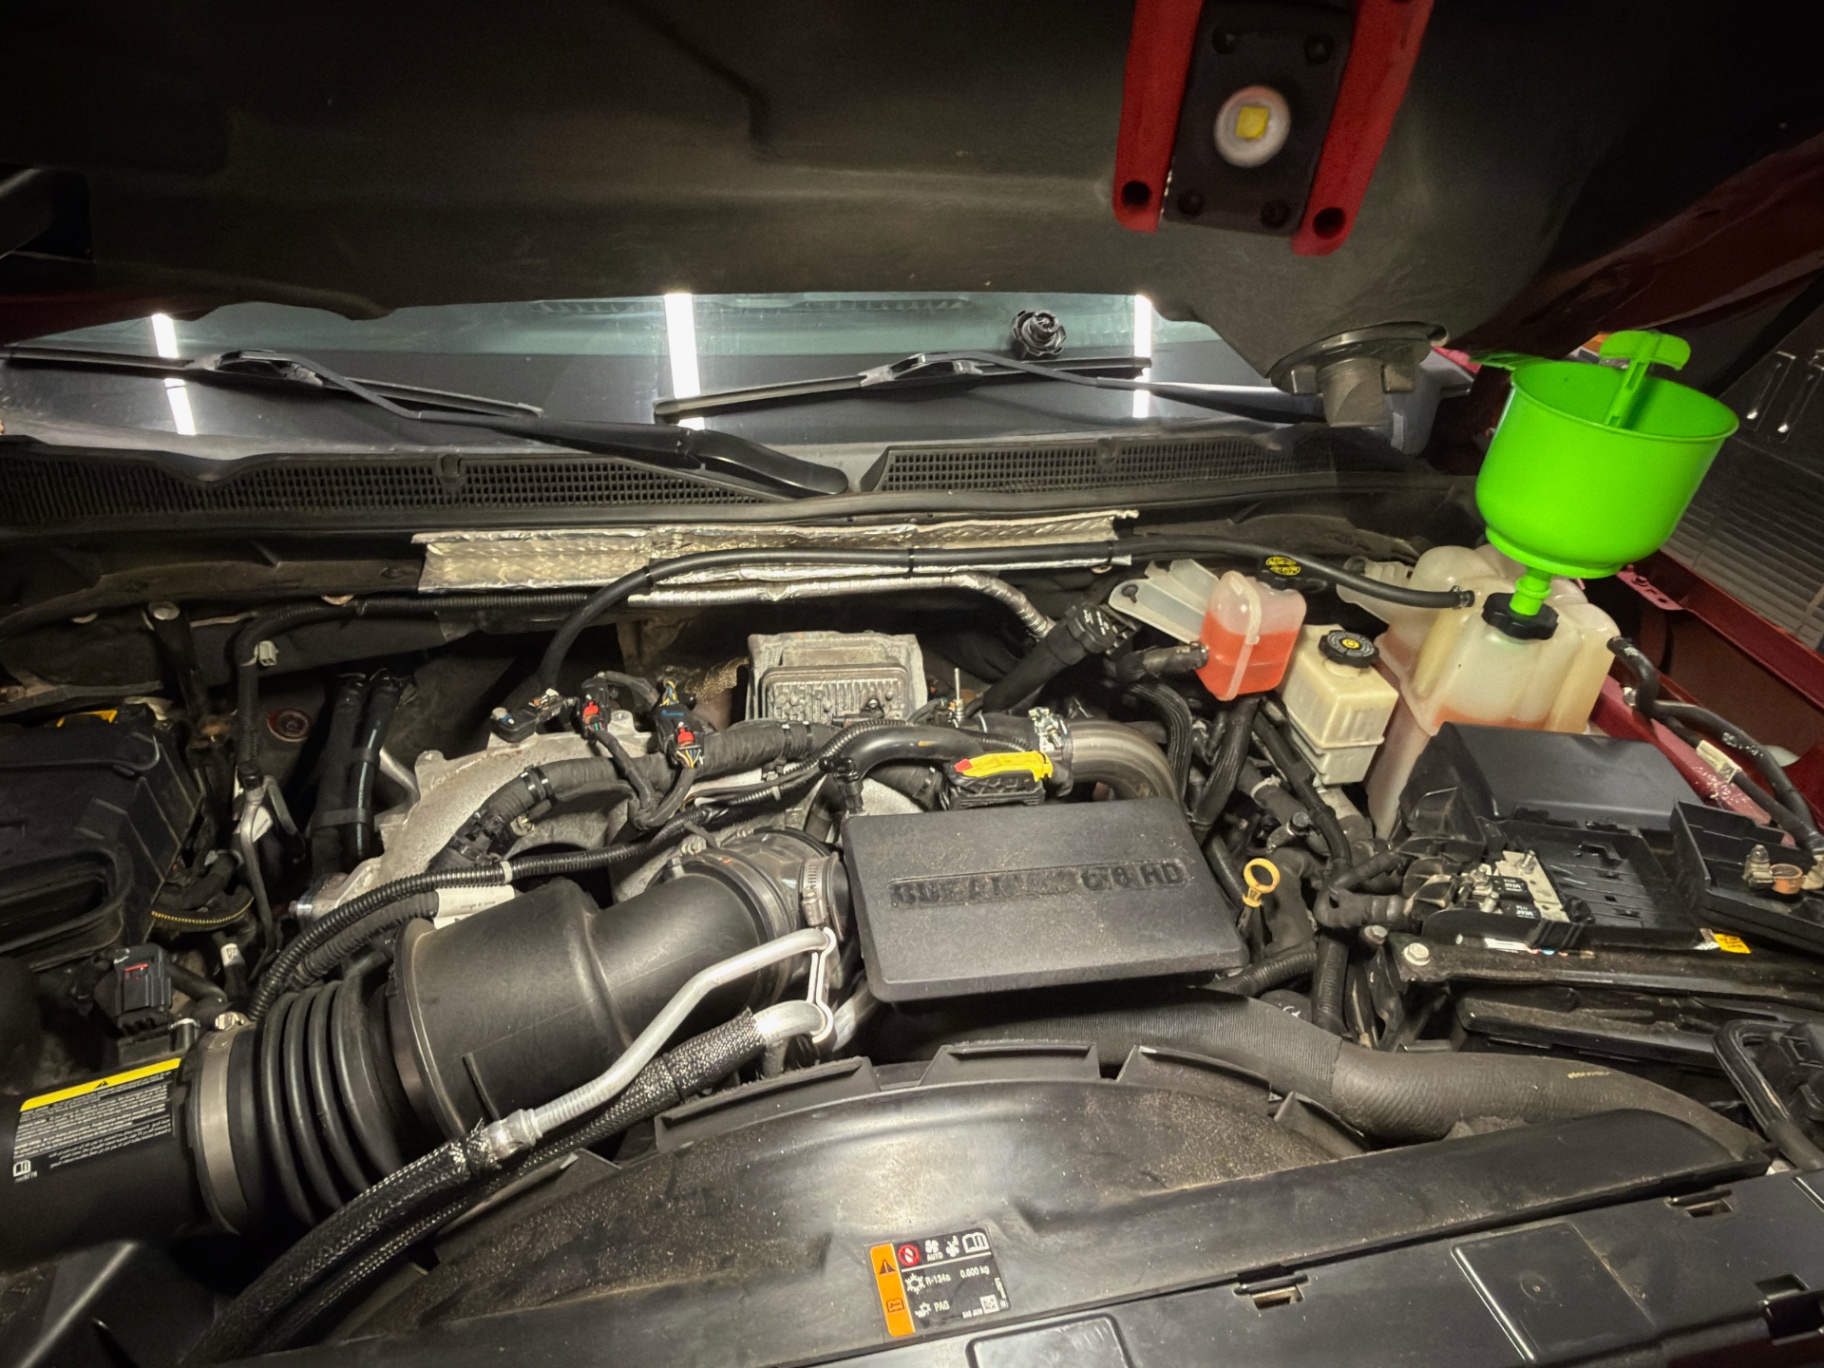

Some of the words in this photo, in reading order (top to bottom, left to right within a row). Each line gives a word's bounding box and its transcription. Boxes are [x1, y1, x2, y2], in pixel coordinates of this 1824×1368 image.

[927, 1251, 943, 1262] AUTO
[925, 1273, 951, 1285] R-134a
[979, 1265, 990, 1275] kg
